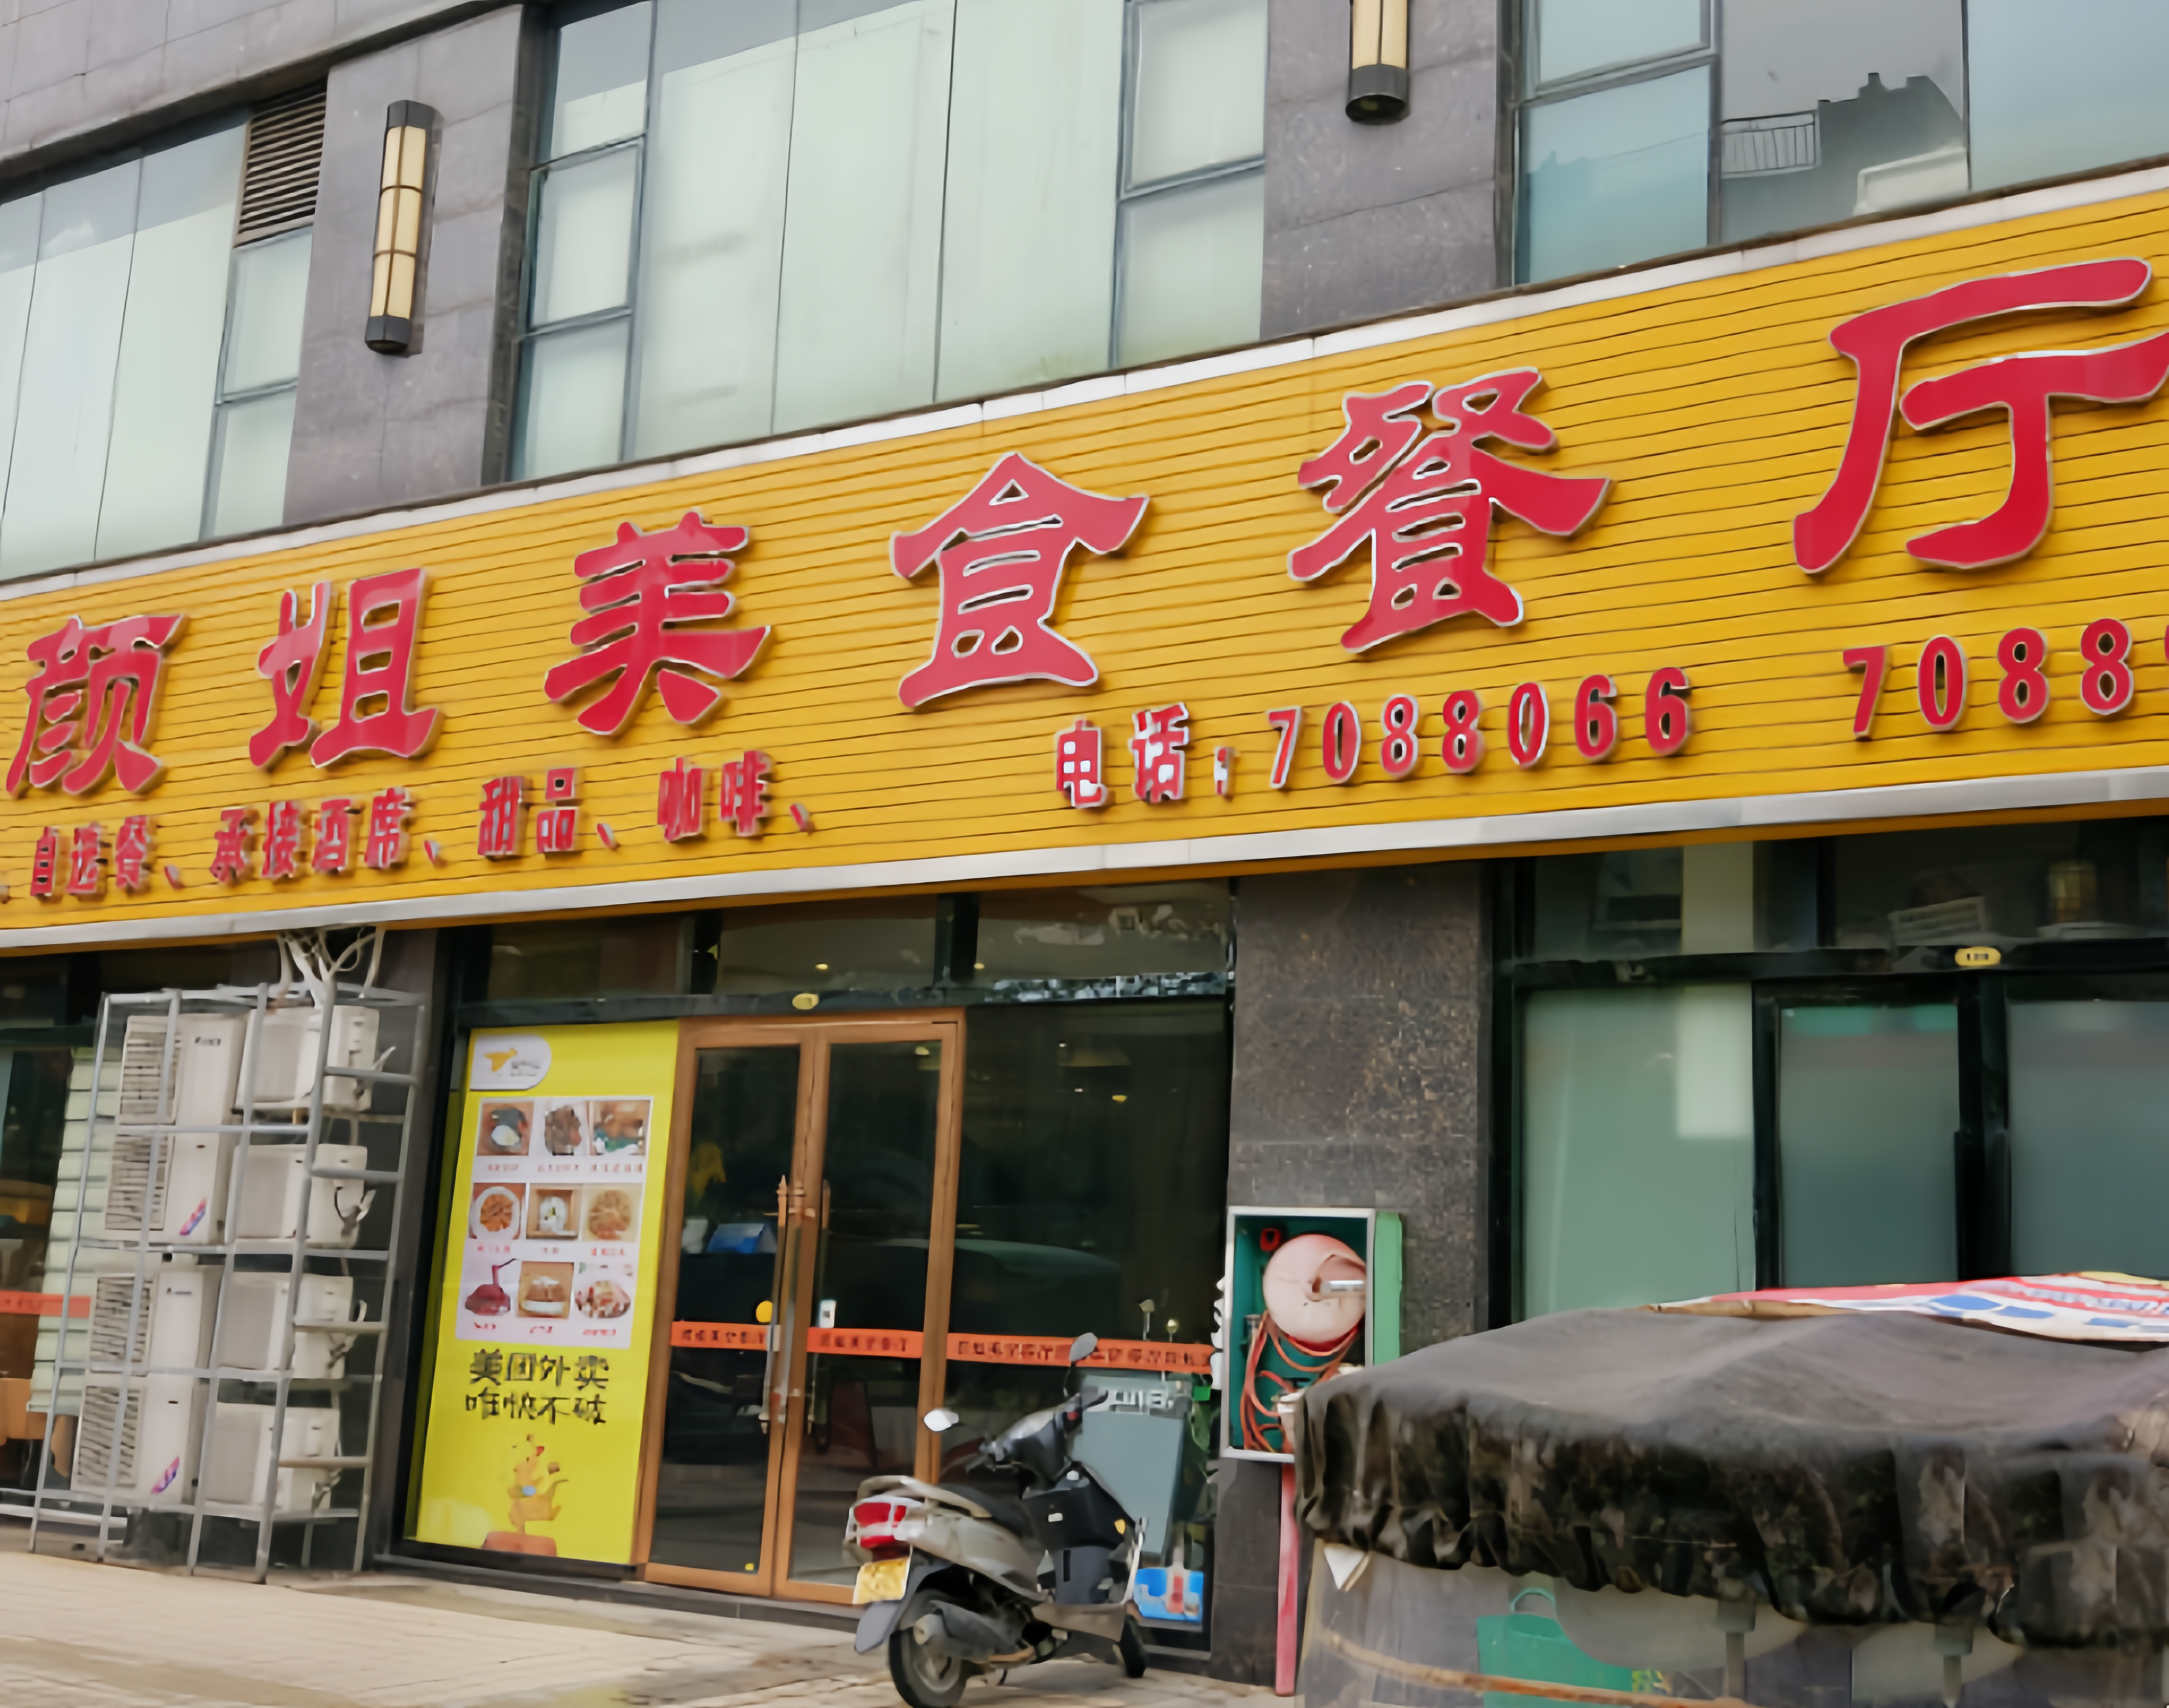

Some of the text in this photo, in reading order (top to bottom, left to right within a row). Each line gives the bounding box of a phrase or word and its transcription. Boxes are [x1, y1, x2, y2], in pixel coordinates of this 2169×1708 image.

[7, 257, 2169, 797] 颜姐美盒餐厅
[1842, 618, 2169, 740] 7088
[470, 1348, 610, 1391] 美团外卖
